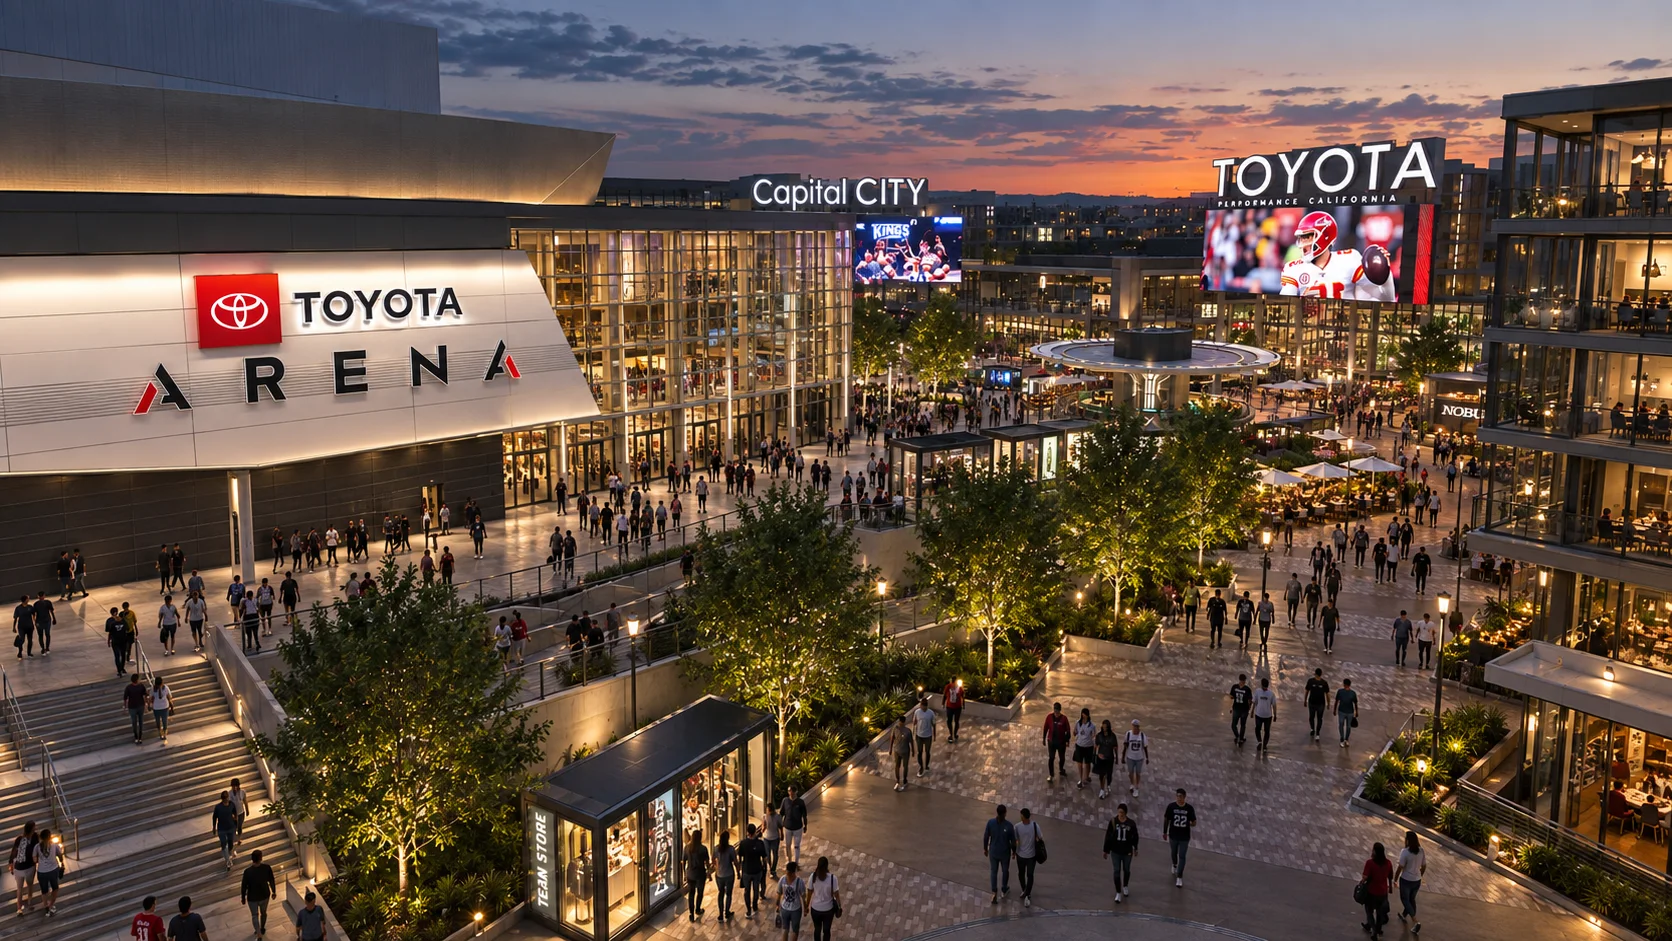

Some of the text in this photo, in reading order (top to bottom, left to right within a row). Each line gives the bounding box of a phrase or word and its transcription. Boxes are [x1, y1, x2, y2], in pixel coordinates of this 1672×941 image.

[1213, 141, 1436, 197] TOYOTA
[753, 178, 926, 211] Capital CITY
[1308, 194, 1397, 204] CALIFORNIA
[870, 223, 910, 240] KINGS
[293, 287, 463, 325] TOYOTA
[132, 339, 522, 415] ARENA
[1441, 404, 1485, 419] NOBU
[535, 811, 548, 864] STORE
[1173, 814, 1187, 828] 22
